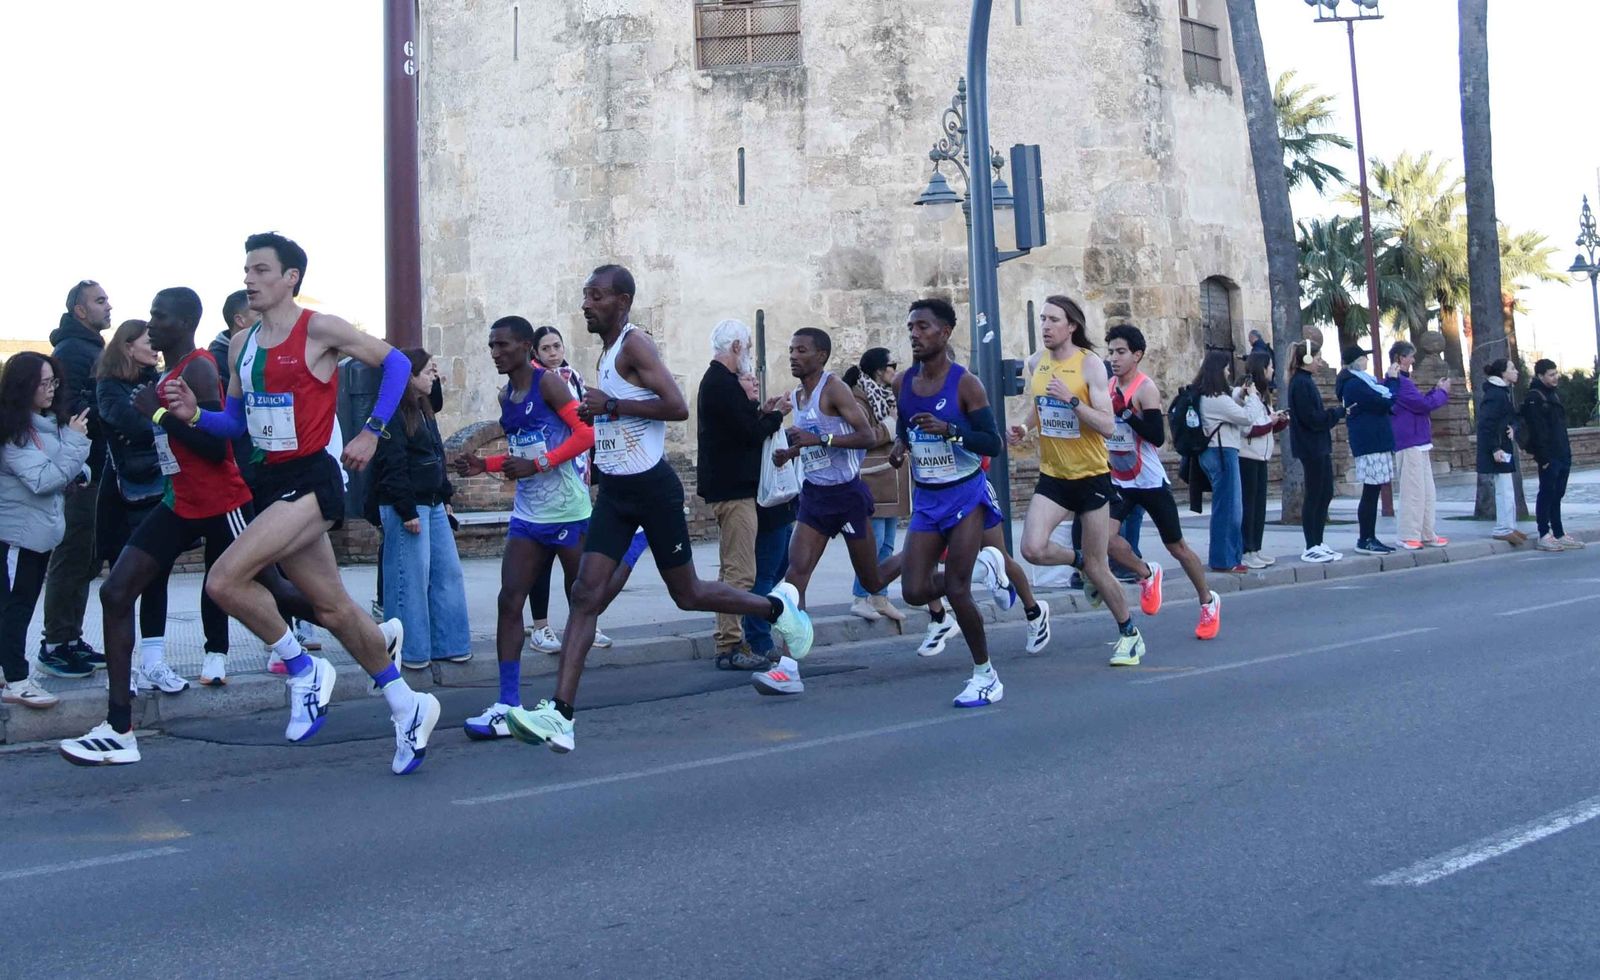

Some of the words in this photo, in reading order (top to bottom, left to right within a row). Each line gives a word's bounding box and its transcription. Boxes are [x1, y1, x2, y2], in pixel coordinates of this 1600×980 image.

[257, 396, 285, 404] ZURICH
[1043, 418, 1074, 429] ANDREW
[263, 425, 273, 437] 49
